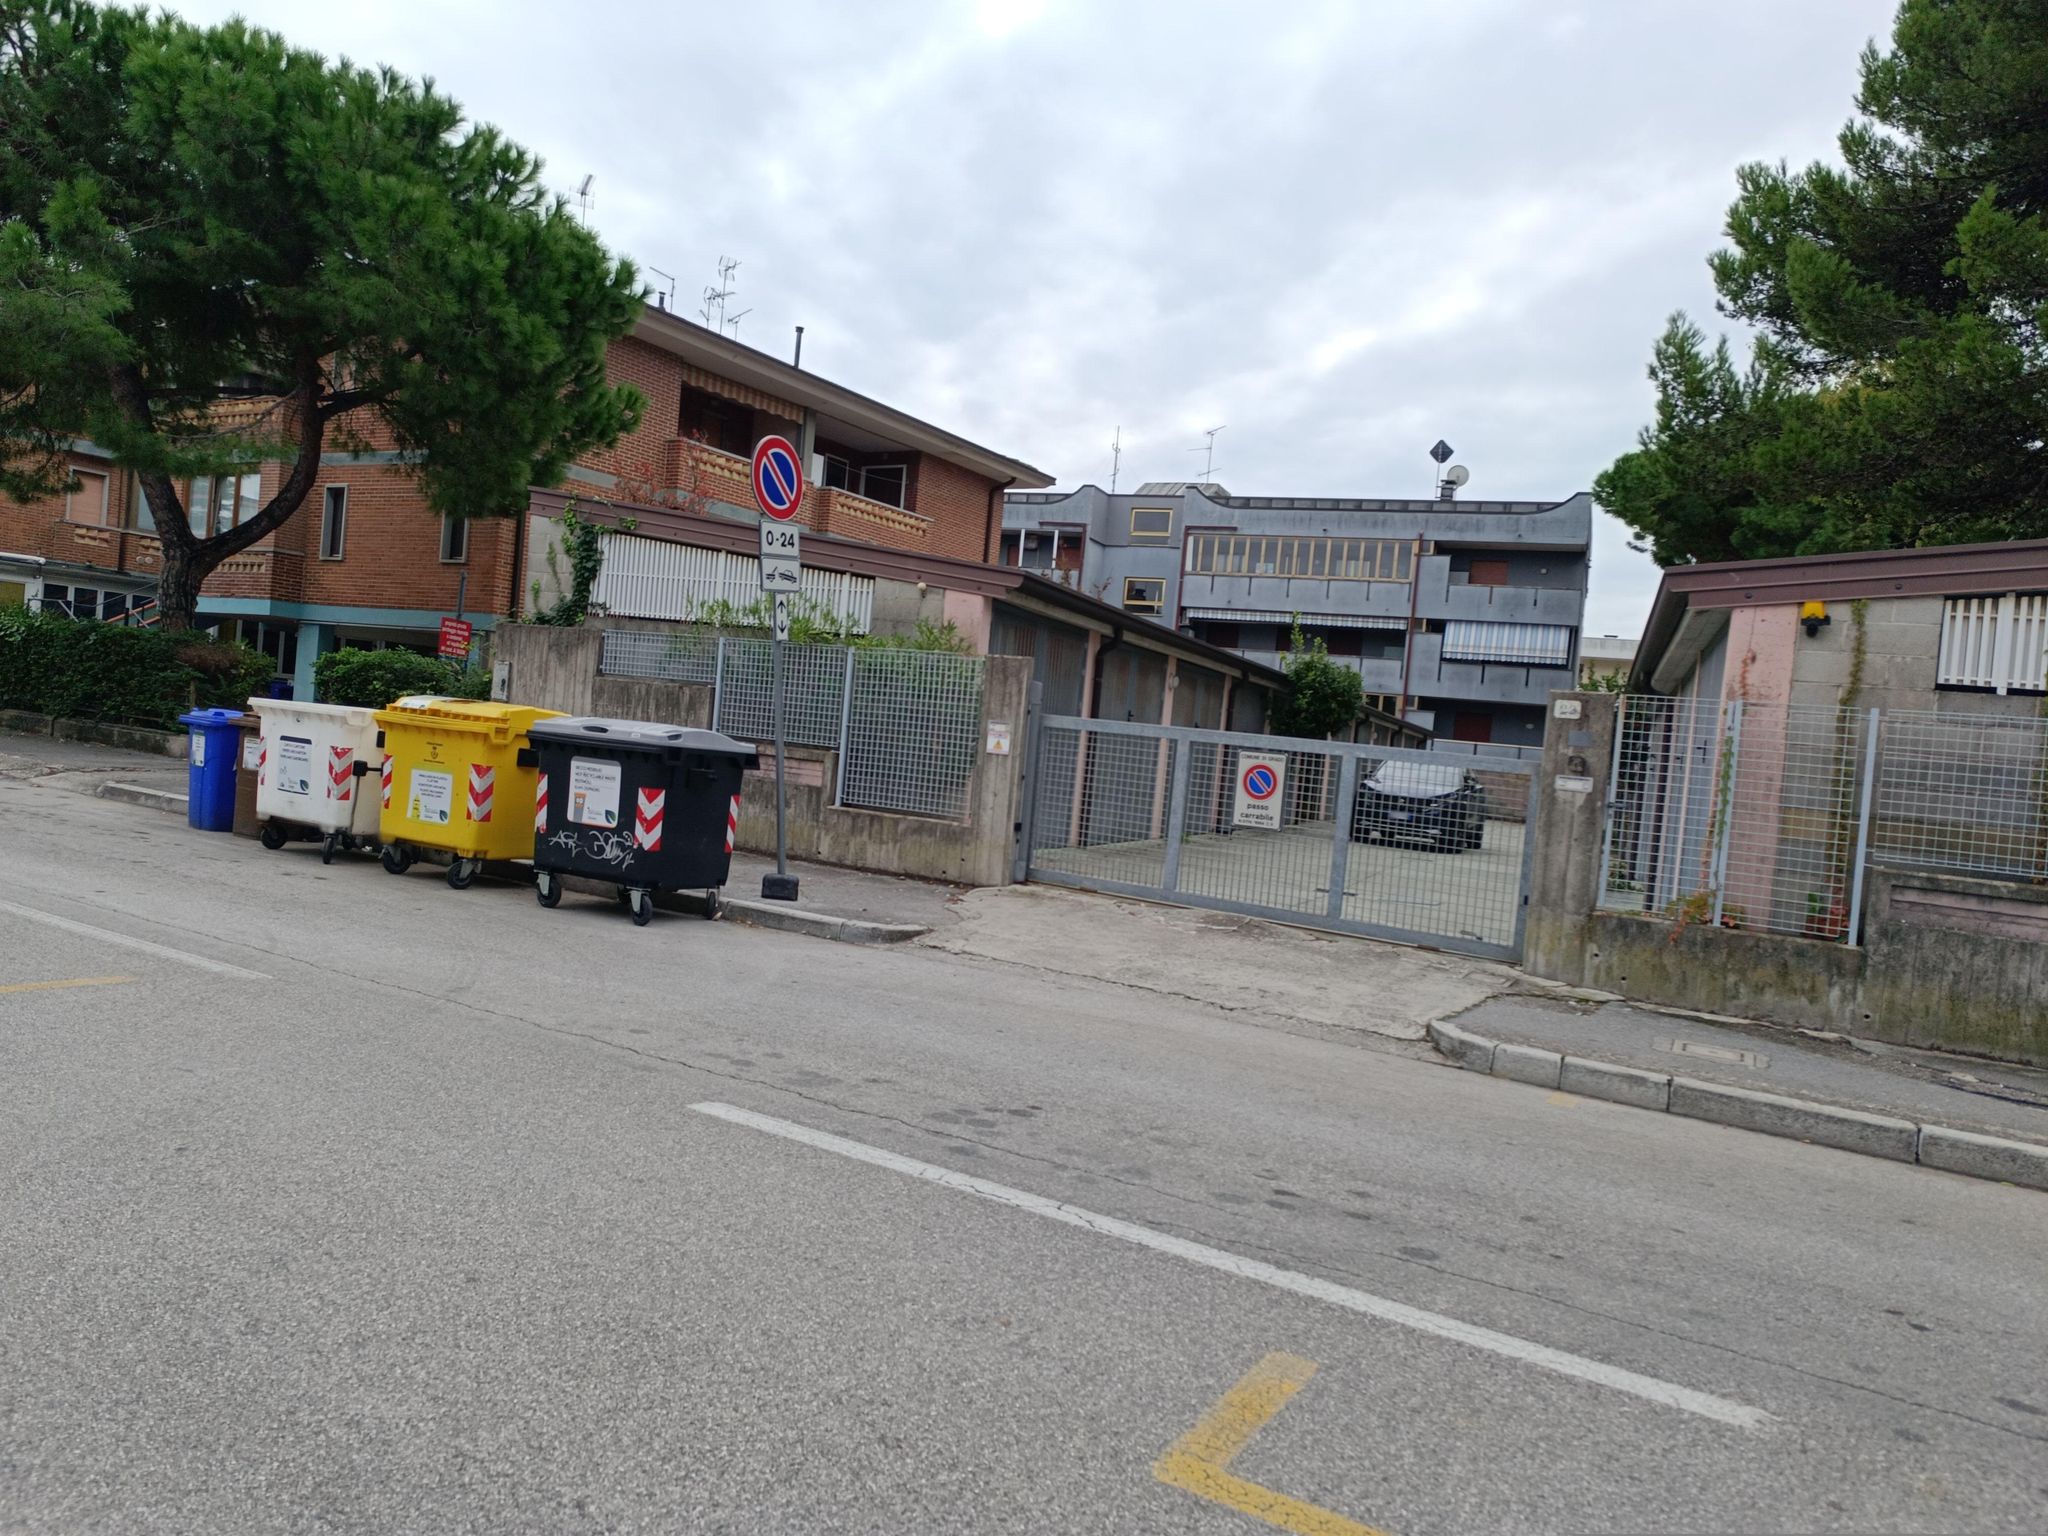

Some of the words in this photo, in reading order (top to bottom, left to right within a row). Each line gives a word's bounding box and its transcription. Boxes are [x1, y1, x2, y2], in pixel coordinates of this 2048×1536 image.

[766, 530, 795, 548] 0-24
[1247, 803, 1269, 811] passo
[1240, 812, 1274, 821] carrabile
